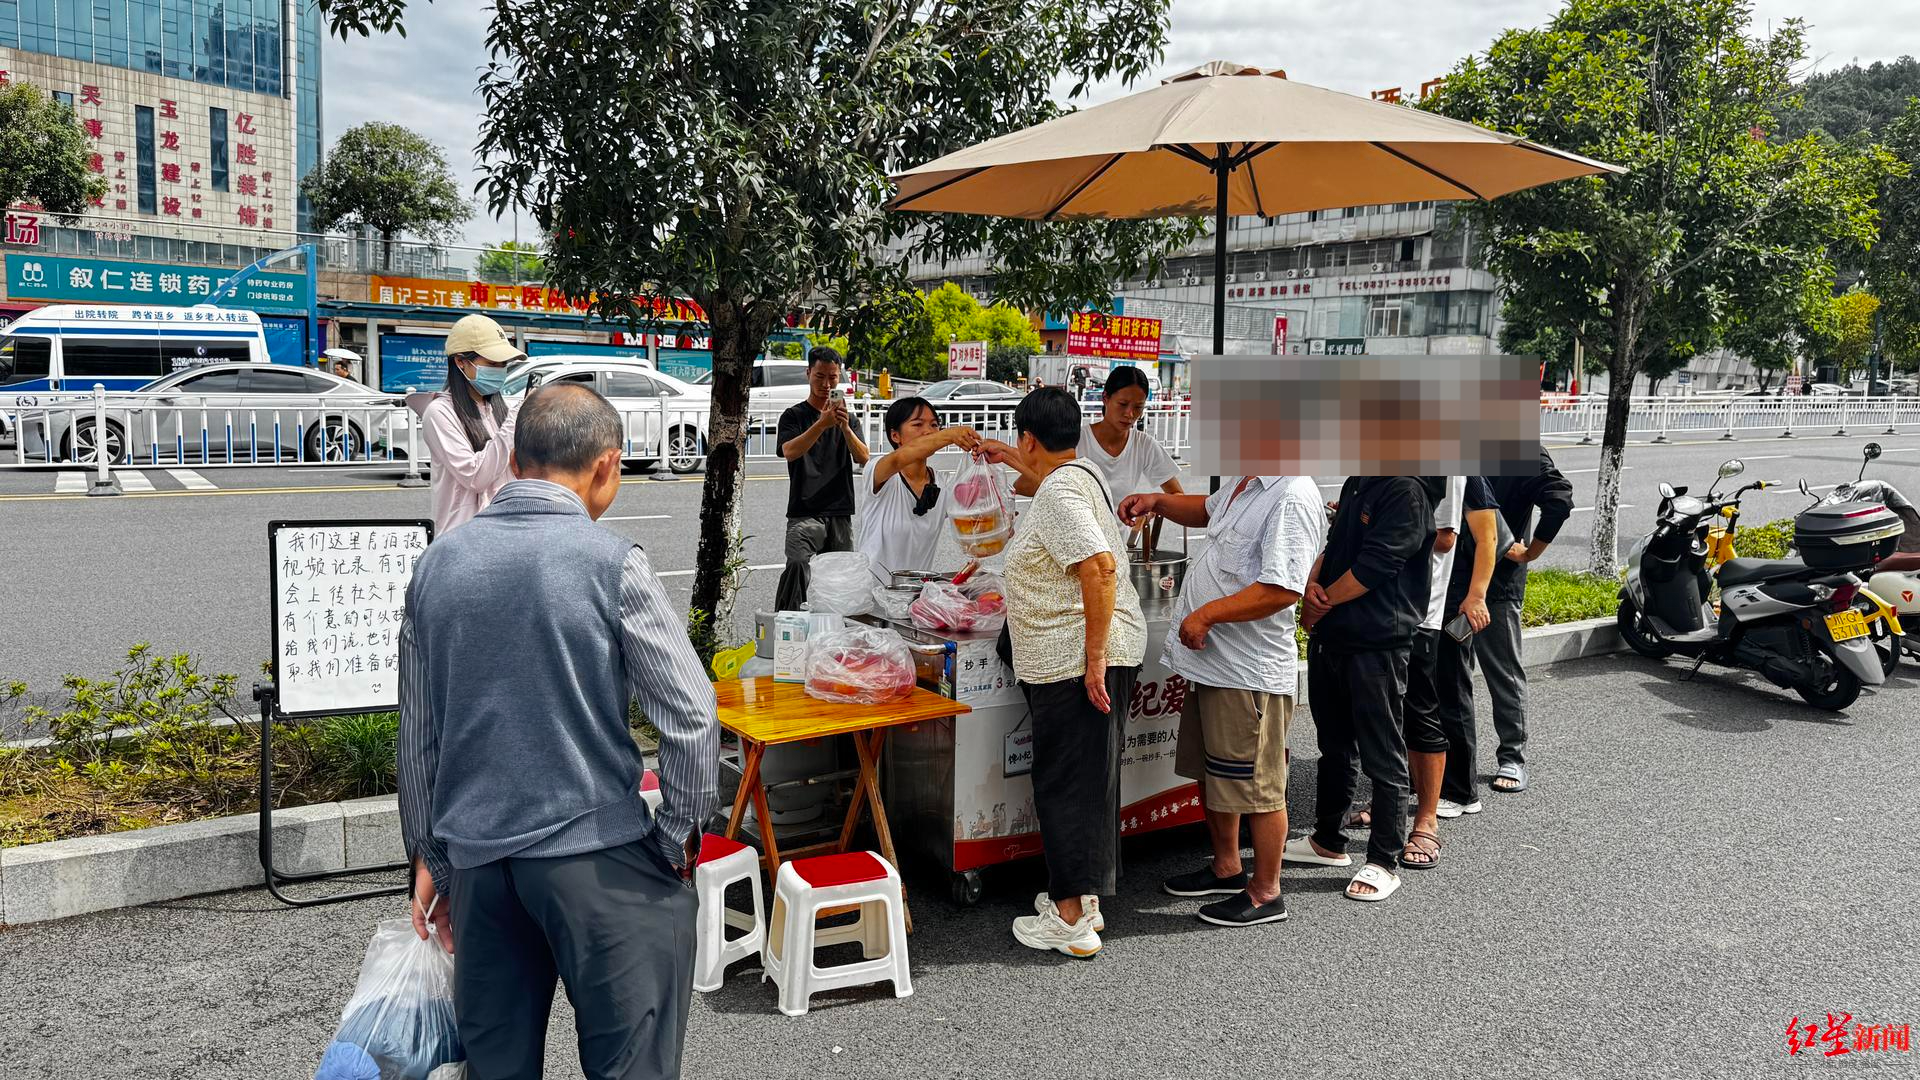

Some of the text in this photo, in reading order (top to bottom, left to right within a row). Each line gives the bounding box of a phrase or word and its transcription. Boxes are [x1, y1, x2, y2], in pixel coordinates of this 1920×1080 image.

[159, 98, 182, 217] 玉龙建设
[235, 111, 258, 227] 亿胜装饰
[5, 214, 40, 246] 场
[74, 309, 249, 323] 出院转院 跨省返乡 返乡老人转运
[964, 658, 988, 670] 抄手
[996, 677, 1003, 689] 3
[1120, 728, 1182, 752] 为需要的人
